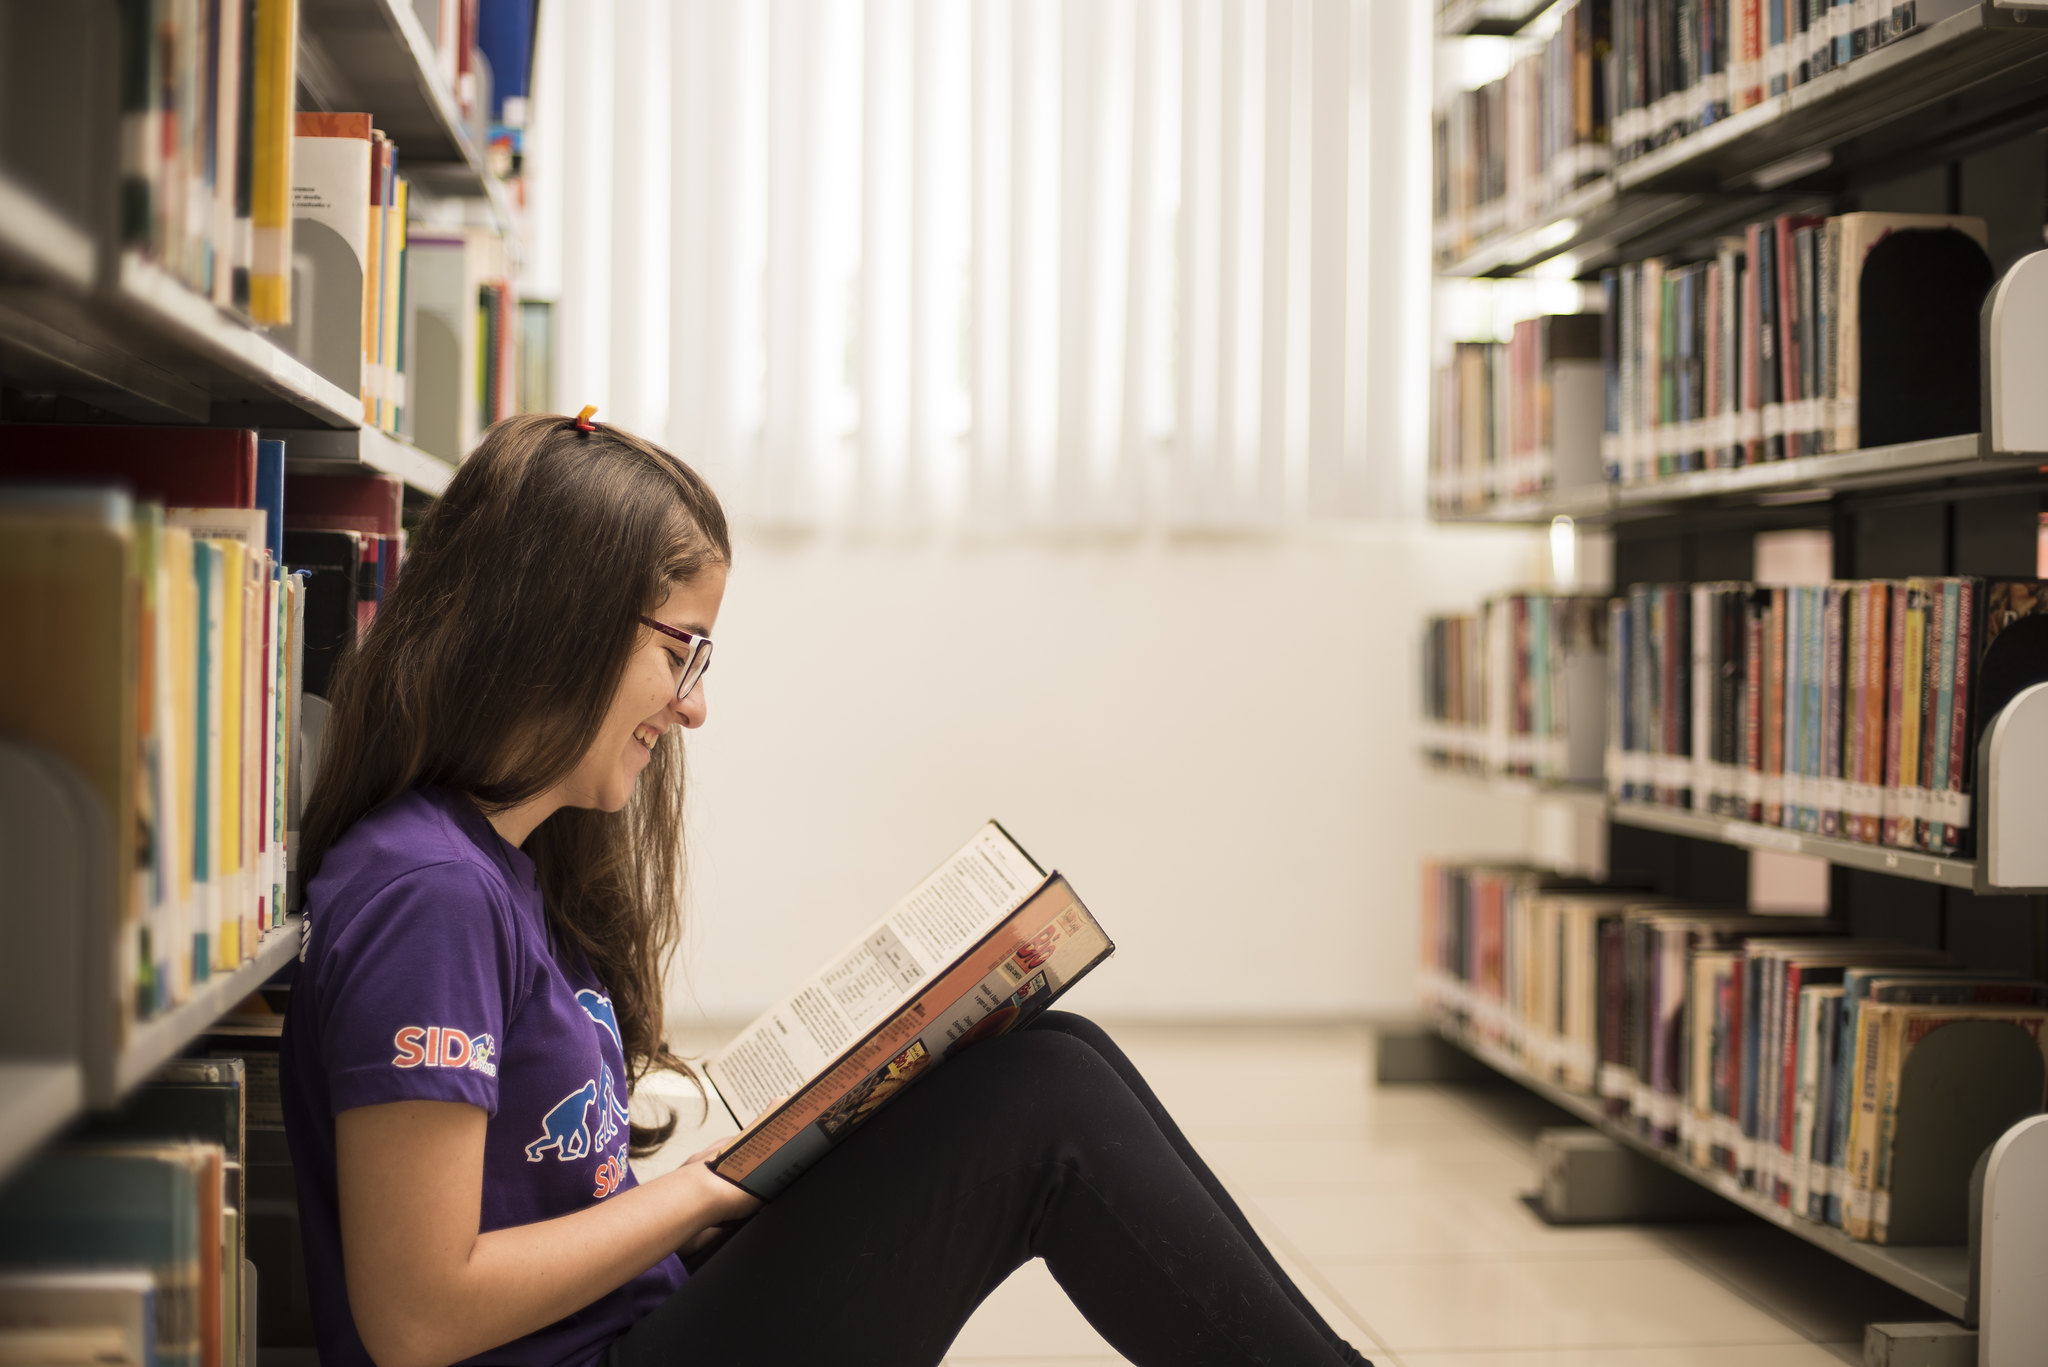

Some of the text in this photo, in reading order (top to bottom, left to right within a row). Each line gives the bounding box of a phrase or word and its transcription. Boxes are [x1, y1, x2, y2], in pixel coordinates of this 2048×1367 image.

[1016, 924, 1061, 969] Bio
[392, 1026, 471, 1068] SID
[892, 1051, 909, 1068] Bio
